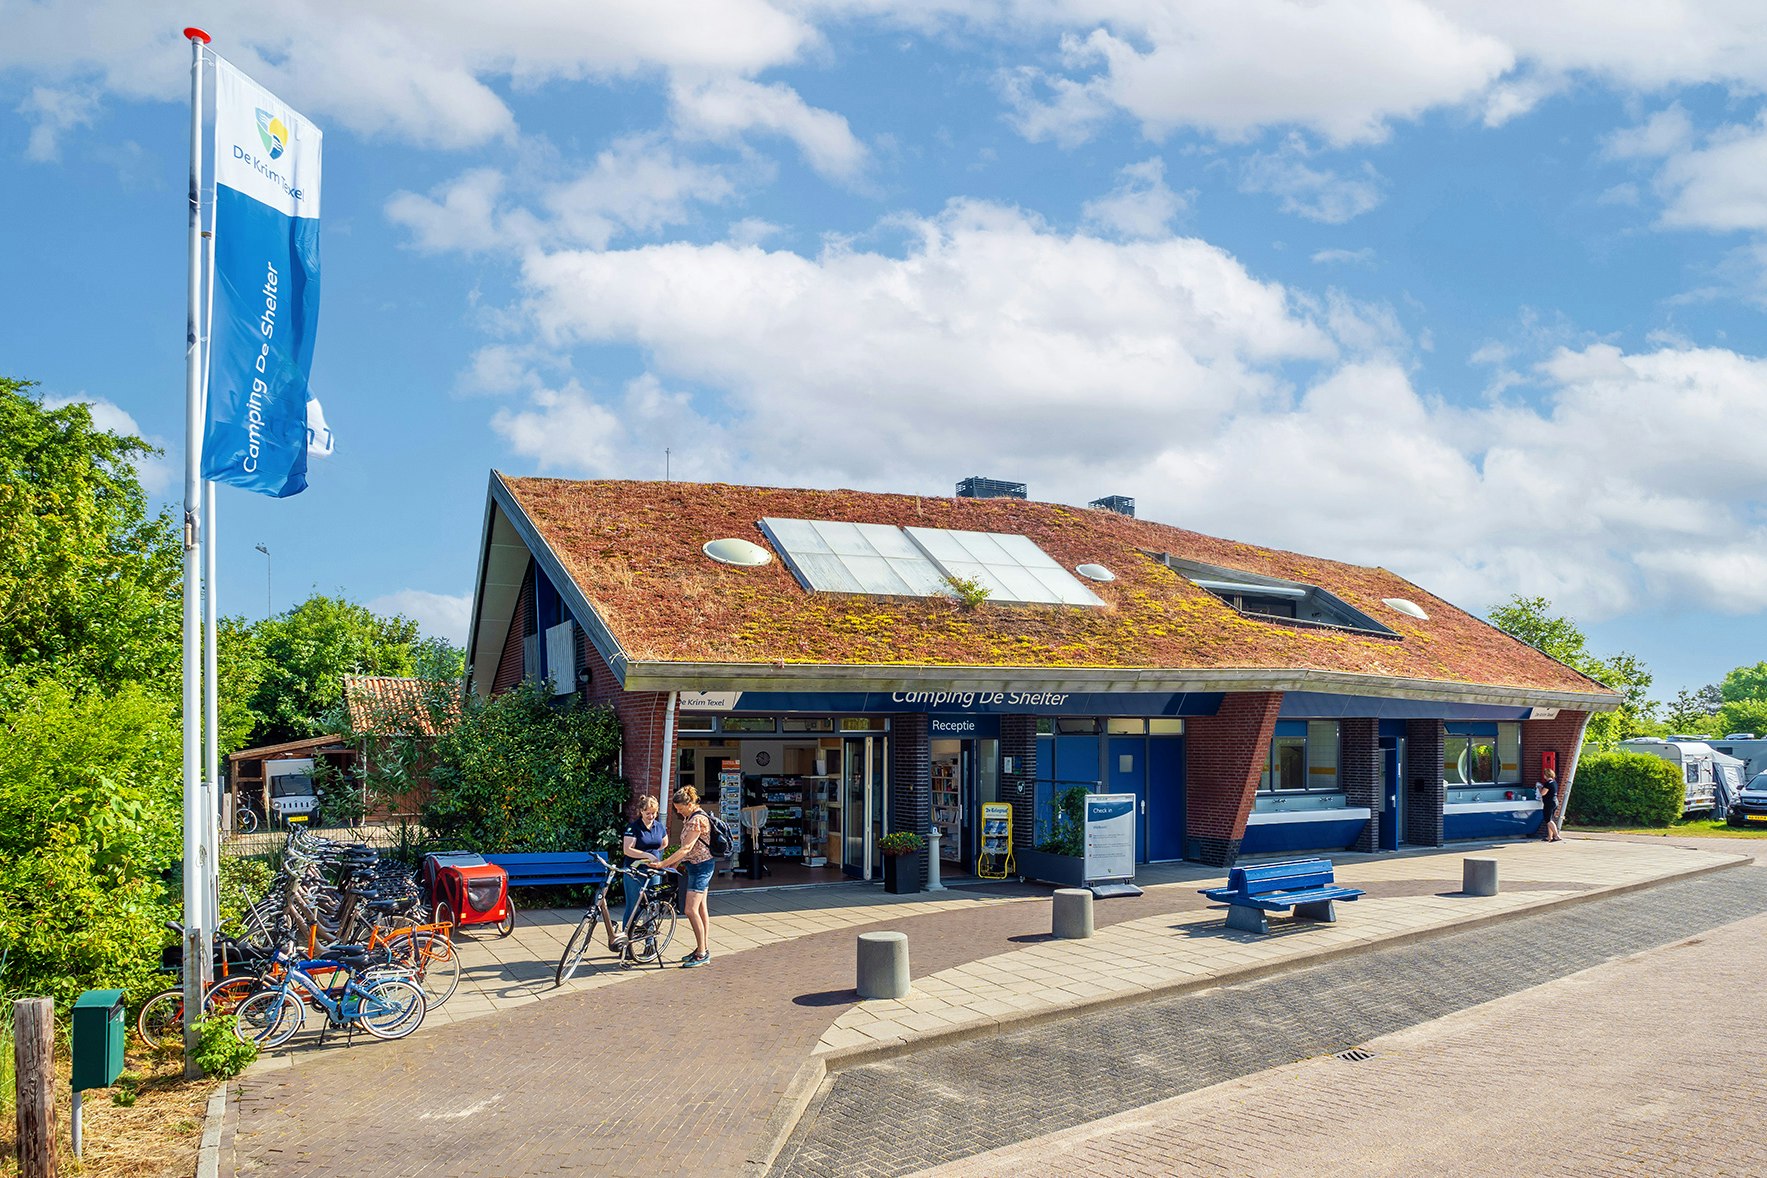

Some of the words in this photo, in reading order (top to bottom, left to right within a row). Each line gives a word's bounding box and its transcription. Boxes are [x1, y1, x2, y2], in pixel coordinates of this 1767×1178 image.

[233, 144, 251, 165] De
[253, 156, 280, 185] Krim
[281, 175, 305, 202] Texel
[261, 261, 278, 339] Shelter
[255, 343, 270, 374] De
[243, 378, 268, 473] Camping
[892, 692, 975, 708] Camping
[979, 692, 1006, 704] De
[1007, 692, 1069, 706] Shelter
[932, 719, 976, 733] Receptie
